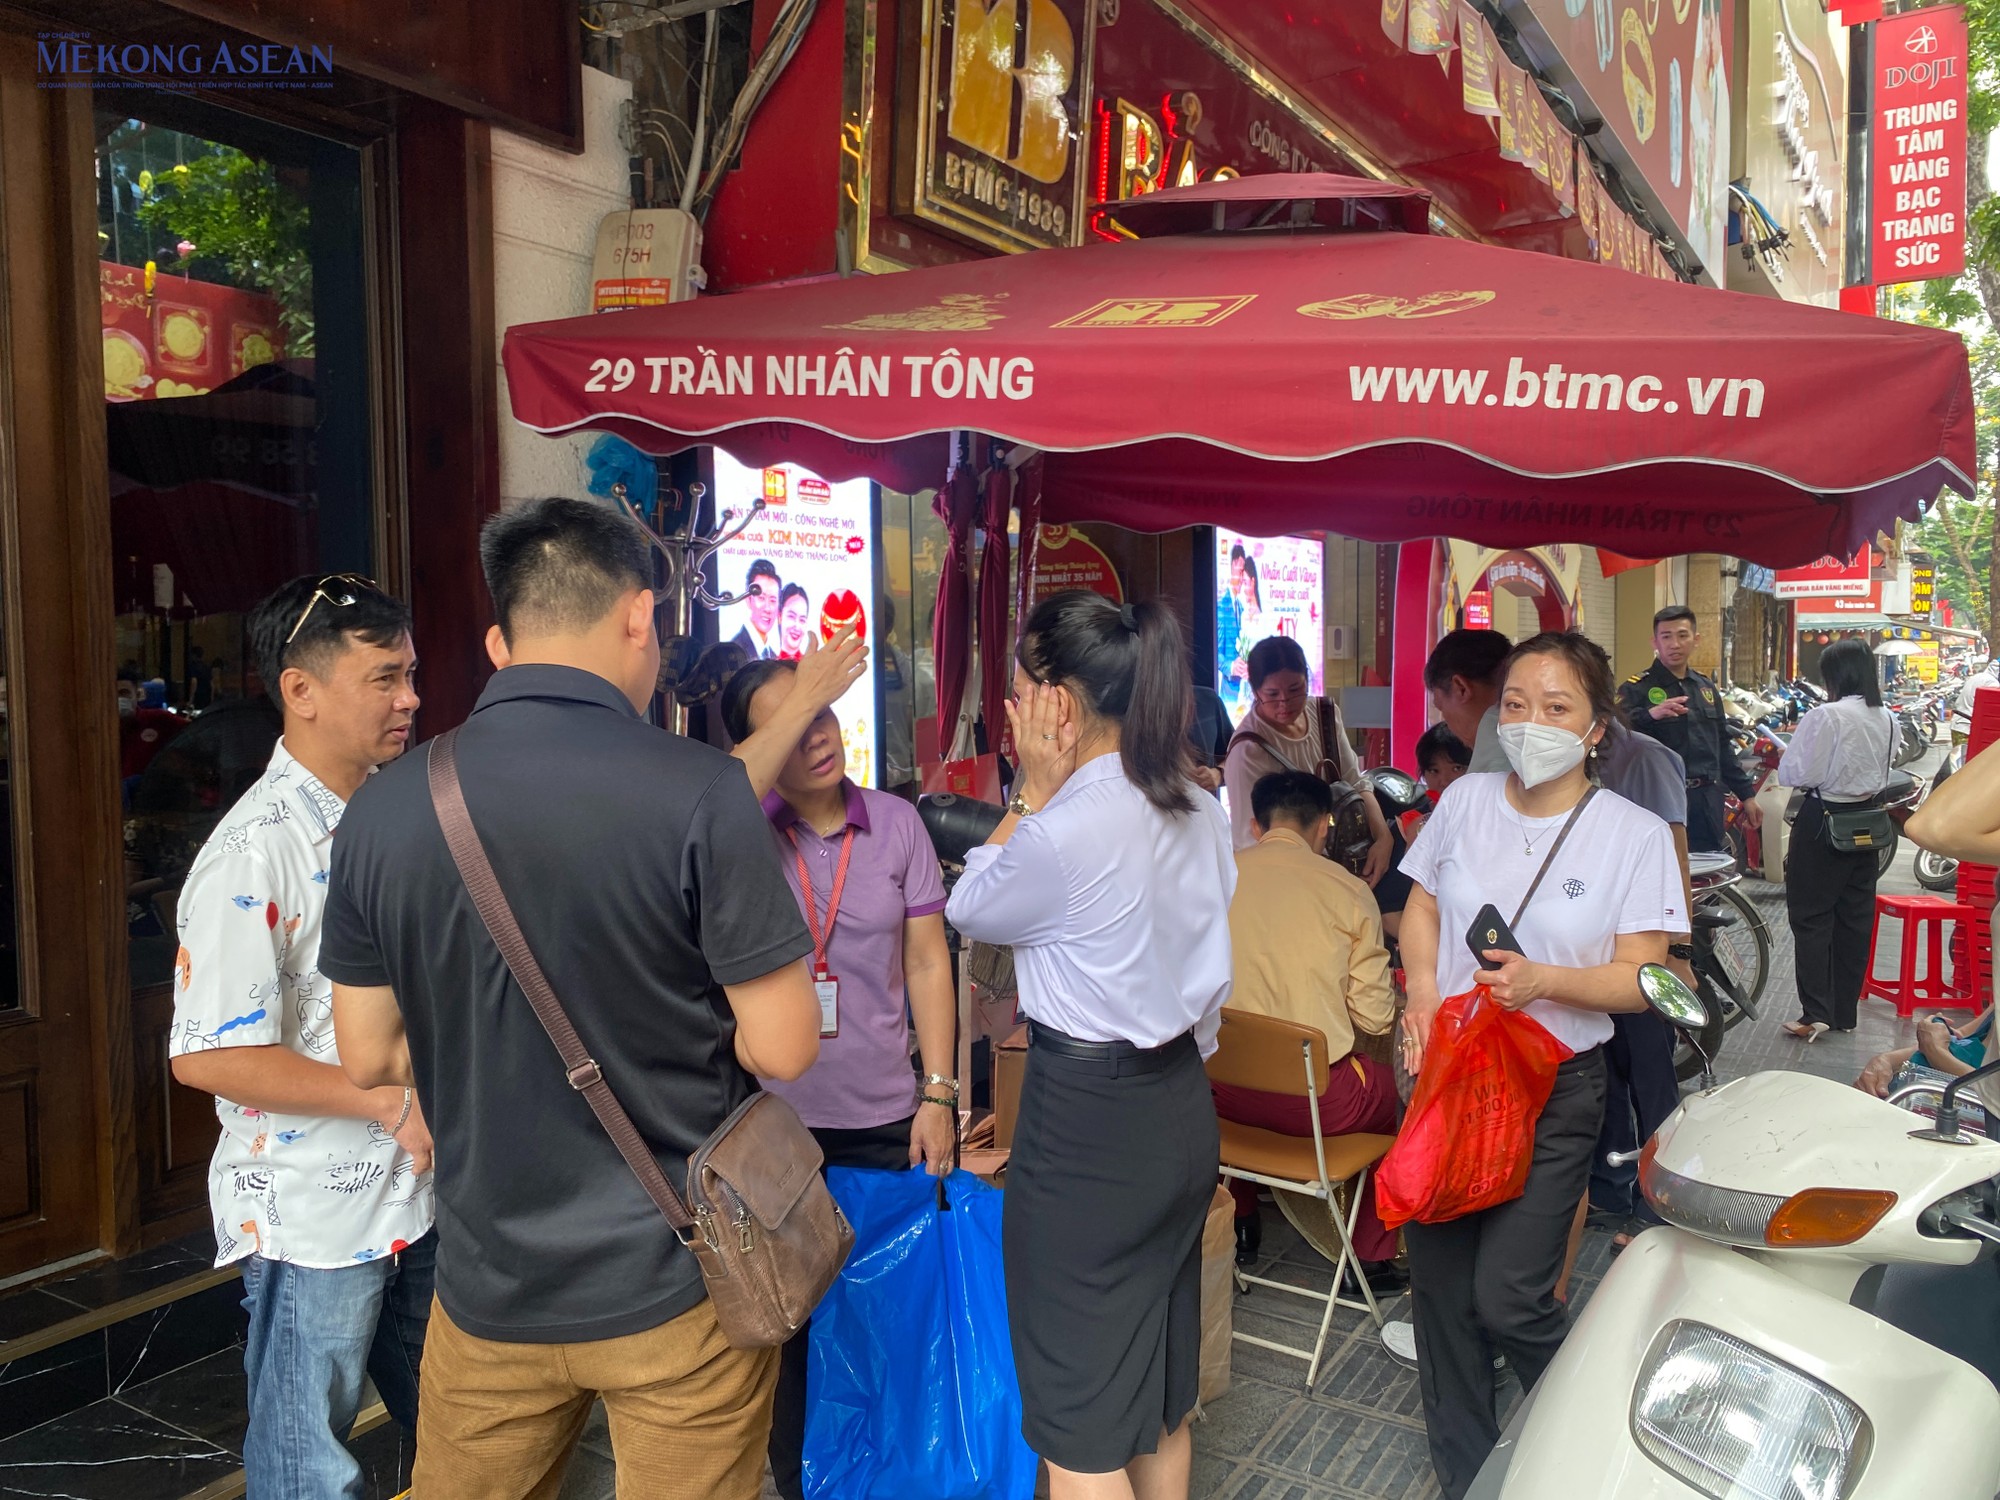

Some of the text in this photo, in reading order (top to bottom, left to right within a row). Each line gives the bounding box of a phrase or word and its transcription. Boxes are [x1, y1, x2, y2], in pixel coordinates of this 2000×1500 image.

[1884, 56, 1957, 90] DOJI
[1883, 98, 1957, 130] TRUNG
[1895, 129, 1944, 156] TÂM
[945, 152, 1009, 211] BTMC
[1889, 156, 1950, 185] VÀNG
[1895, 186, 1941, 214] BẠC
[1882, 212, 1955, 242] TRANG
[1895, 241, 1941, 268] SỨC
[584, 345, 1034, 400] 29 TRẦN NHÂN TÔNG
[1349, 356, 1765, 418] www.btmc.vn
[768, 529, 793, 546] KIM
[795, 532, 844, 551] NGUYỆT
